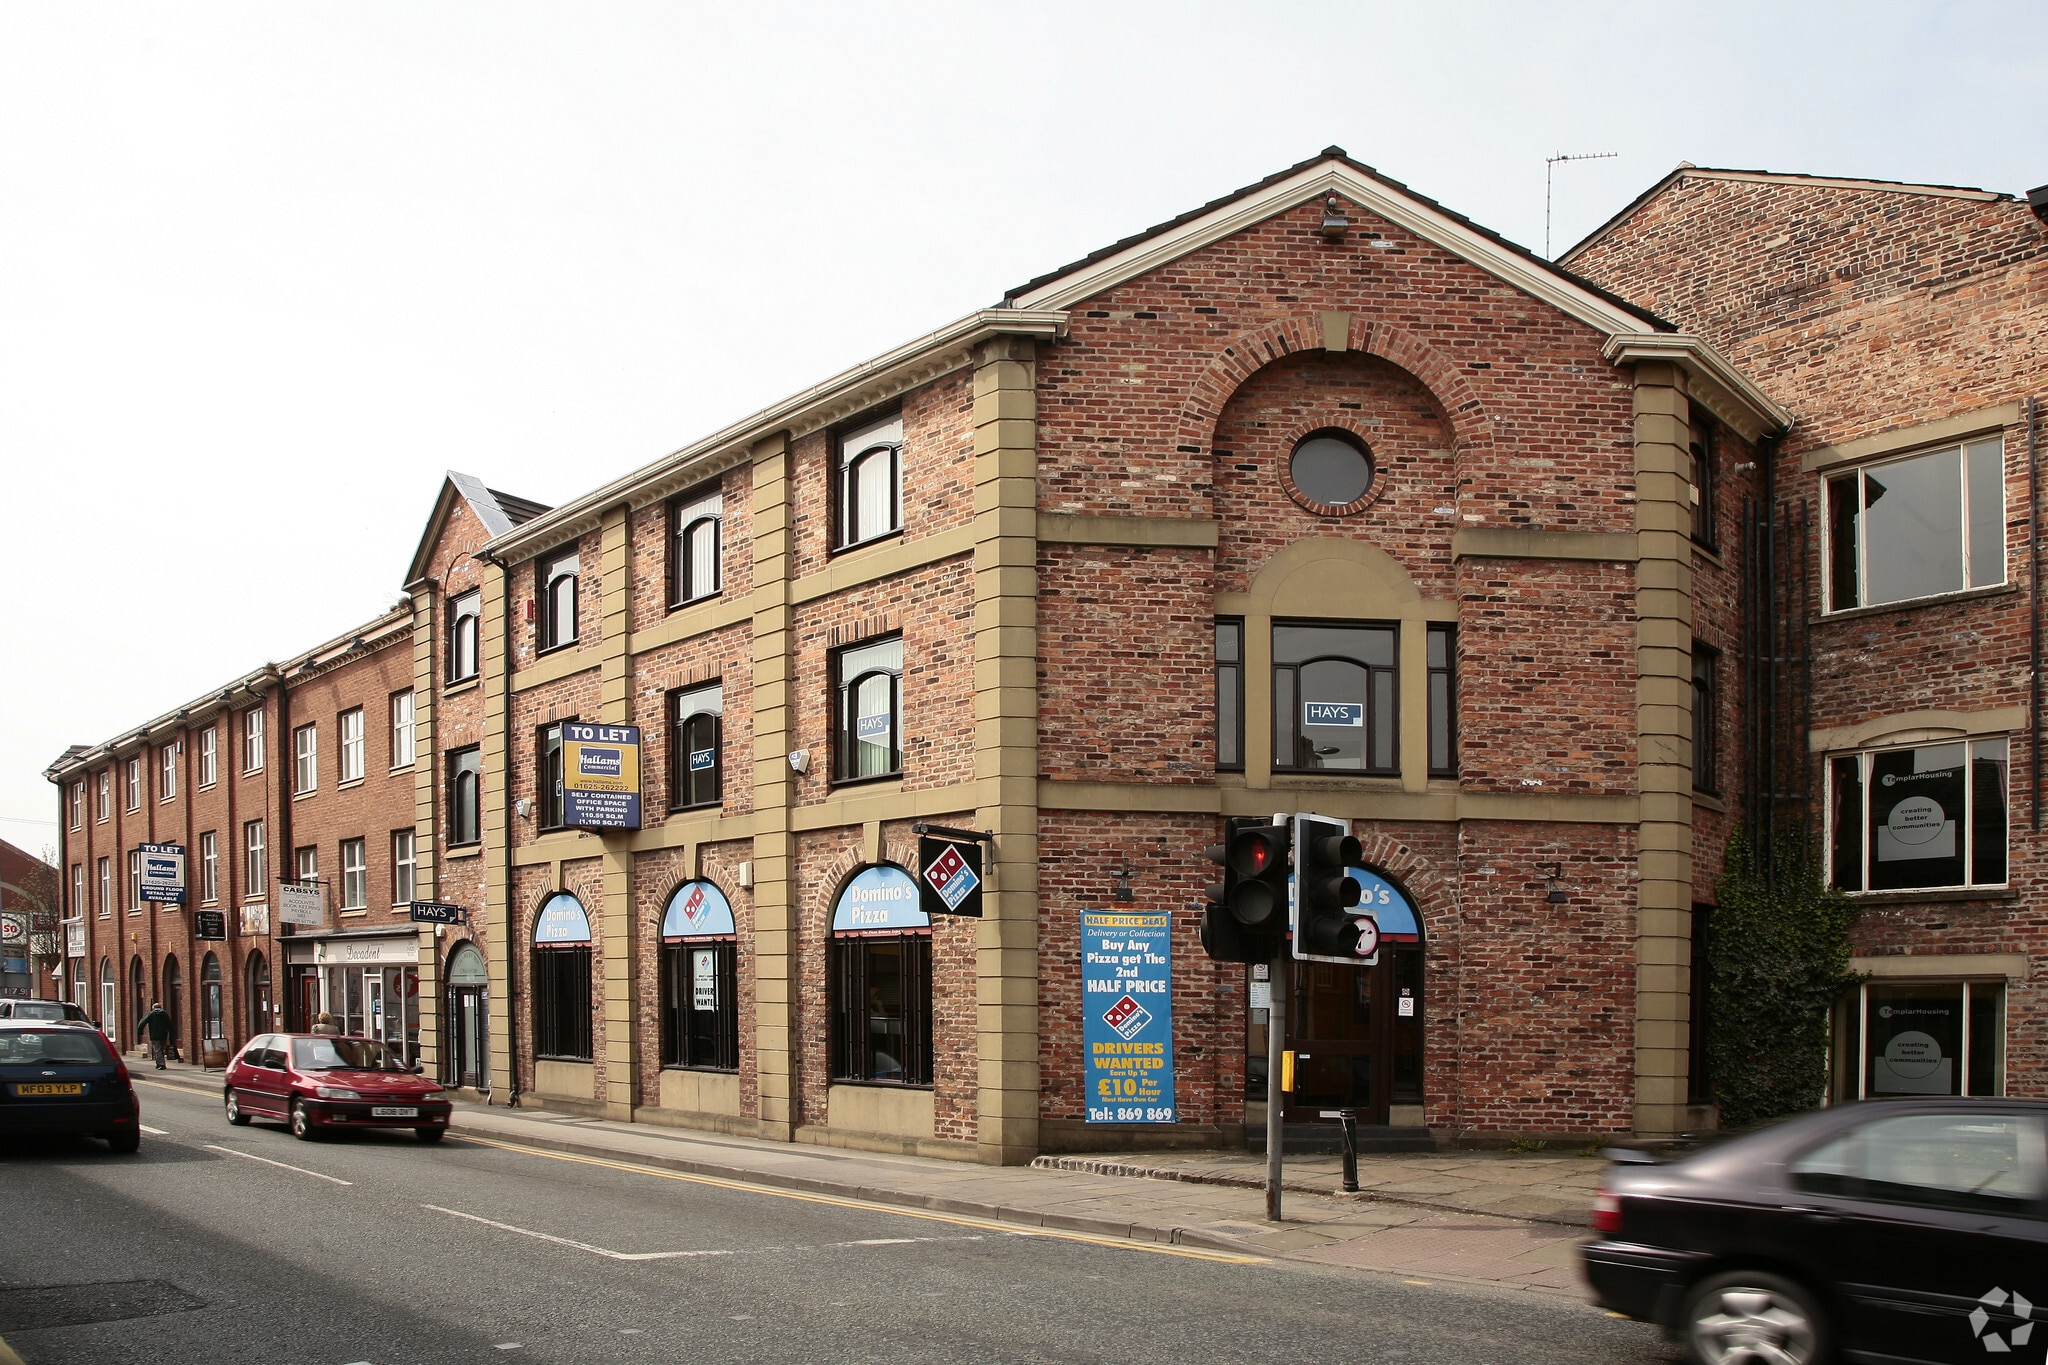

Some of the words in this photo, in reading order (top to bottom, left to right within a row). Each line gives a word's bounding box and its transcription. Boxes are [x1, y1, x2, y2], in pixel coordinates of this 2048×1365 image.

[1312, 706, 1348, 718] HAYS
[860, 716, 882, 731] HAYS
[571, 726, 594, 740] TO
[599, 728, 630, 742] LET
[580, 754, 620, 765] Hallams
[692, 752, 710, 764] HAYS
[1886, 772, 1952, 782] TemplarHousing
[574, 783, 628, 791] 01625-262222
[1892, 822, 1940, 830] communities
[942, 869, 968, 898] Domino's
[283, 887, 320, 895] CABSYS
[851, 881, 912, 903] Domino's
[948, 886, 966, 905] Pizza
[417, 906, 446, 918] HAYS
[546, 906, 581, 922] Domino's
[851, 905, 888, 924] Pizza
[546, 924, 568, 938] Pizza
[1087, 929, 1118, 938] Delivery
[1102, 939, 1124, 952] Buy
[1127, 940, 1149, 952] Any
[1087, 952, 1118, 964] Pizza
[1122, 954, 1141, 966] get
[1144, 953, 1166, 964] The
[1116, 966, 1138, 978] 2nd
[1088, 980, 1121, 993] HALF
[1126, 980, 1166, 993] PRICE
[1118, 1009, 1144, 1032] Domino's
[1124, 1022, 1142, 1037] Pizza
[1092, 1042, 1164, 1054] DRIVERS
[1094, 1057, 1164, 1069] WANTED
[22, 1085, 52, 1093] MF03
[1098, 1079, 1137, 1095] £10
[1089, 1107, 1113, 1120] Tel:
[1117, 1108, 1143, 1120] 869
[1146, 1108, 1172, 1120] 869
